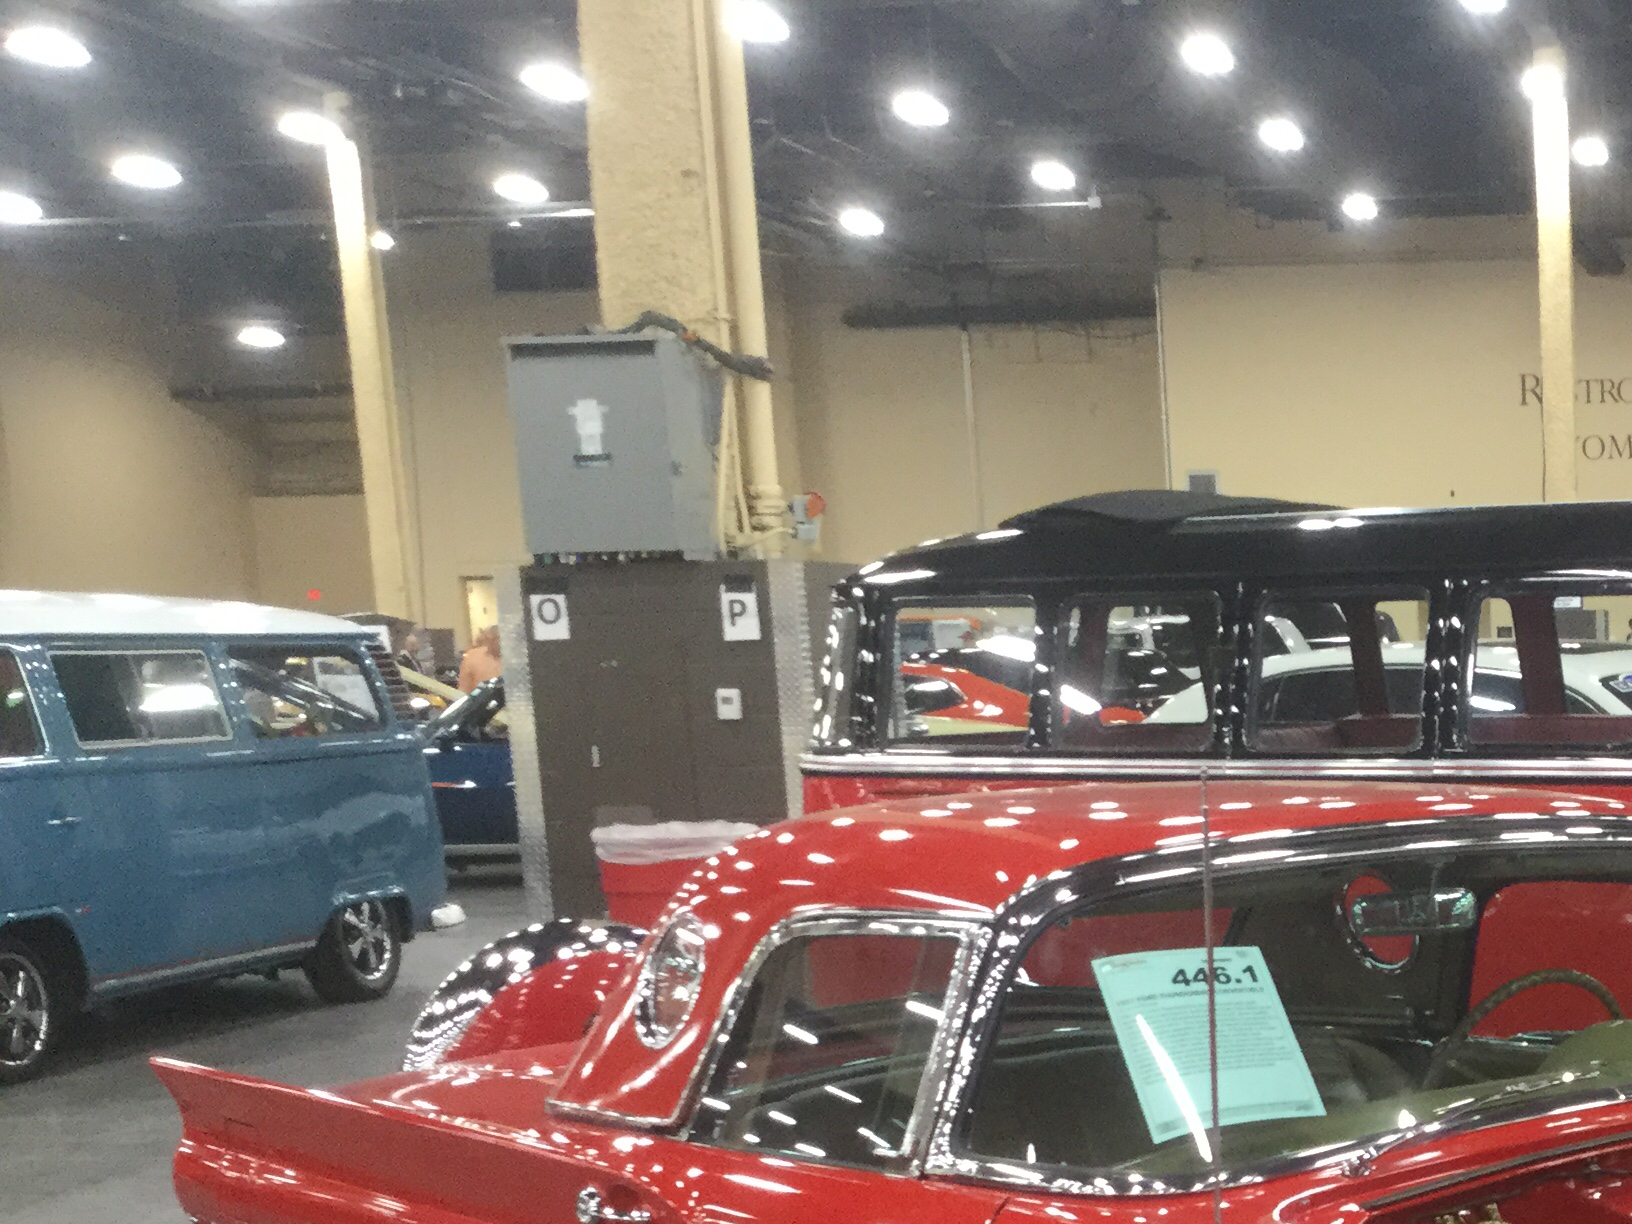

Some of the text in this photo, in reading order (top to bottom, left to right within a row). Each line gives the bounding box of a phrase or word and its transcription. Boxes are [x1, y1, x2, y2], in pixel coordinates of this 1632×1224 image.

[537, 597, 561, 625] O
[728, 598, 747, 627] P
[1171, 964, 1259, 987] 446.1
